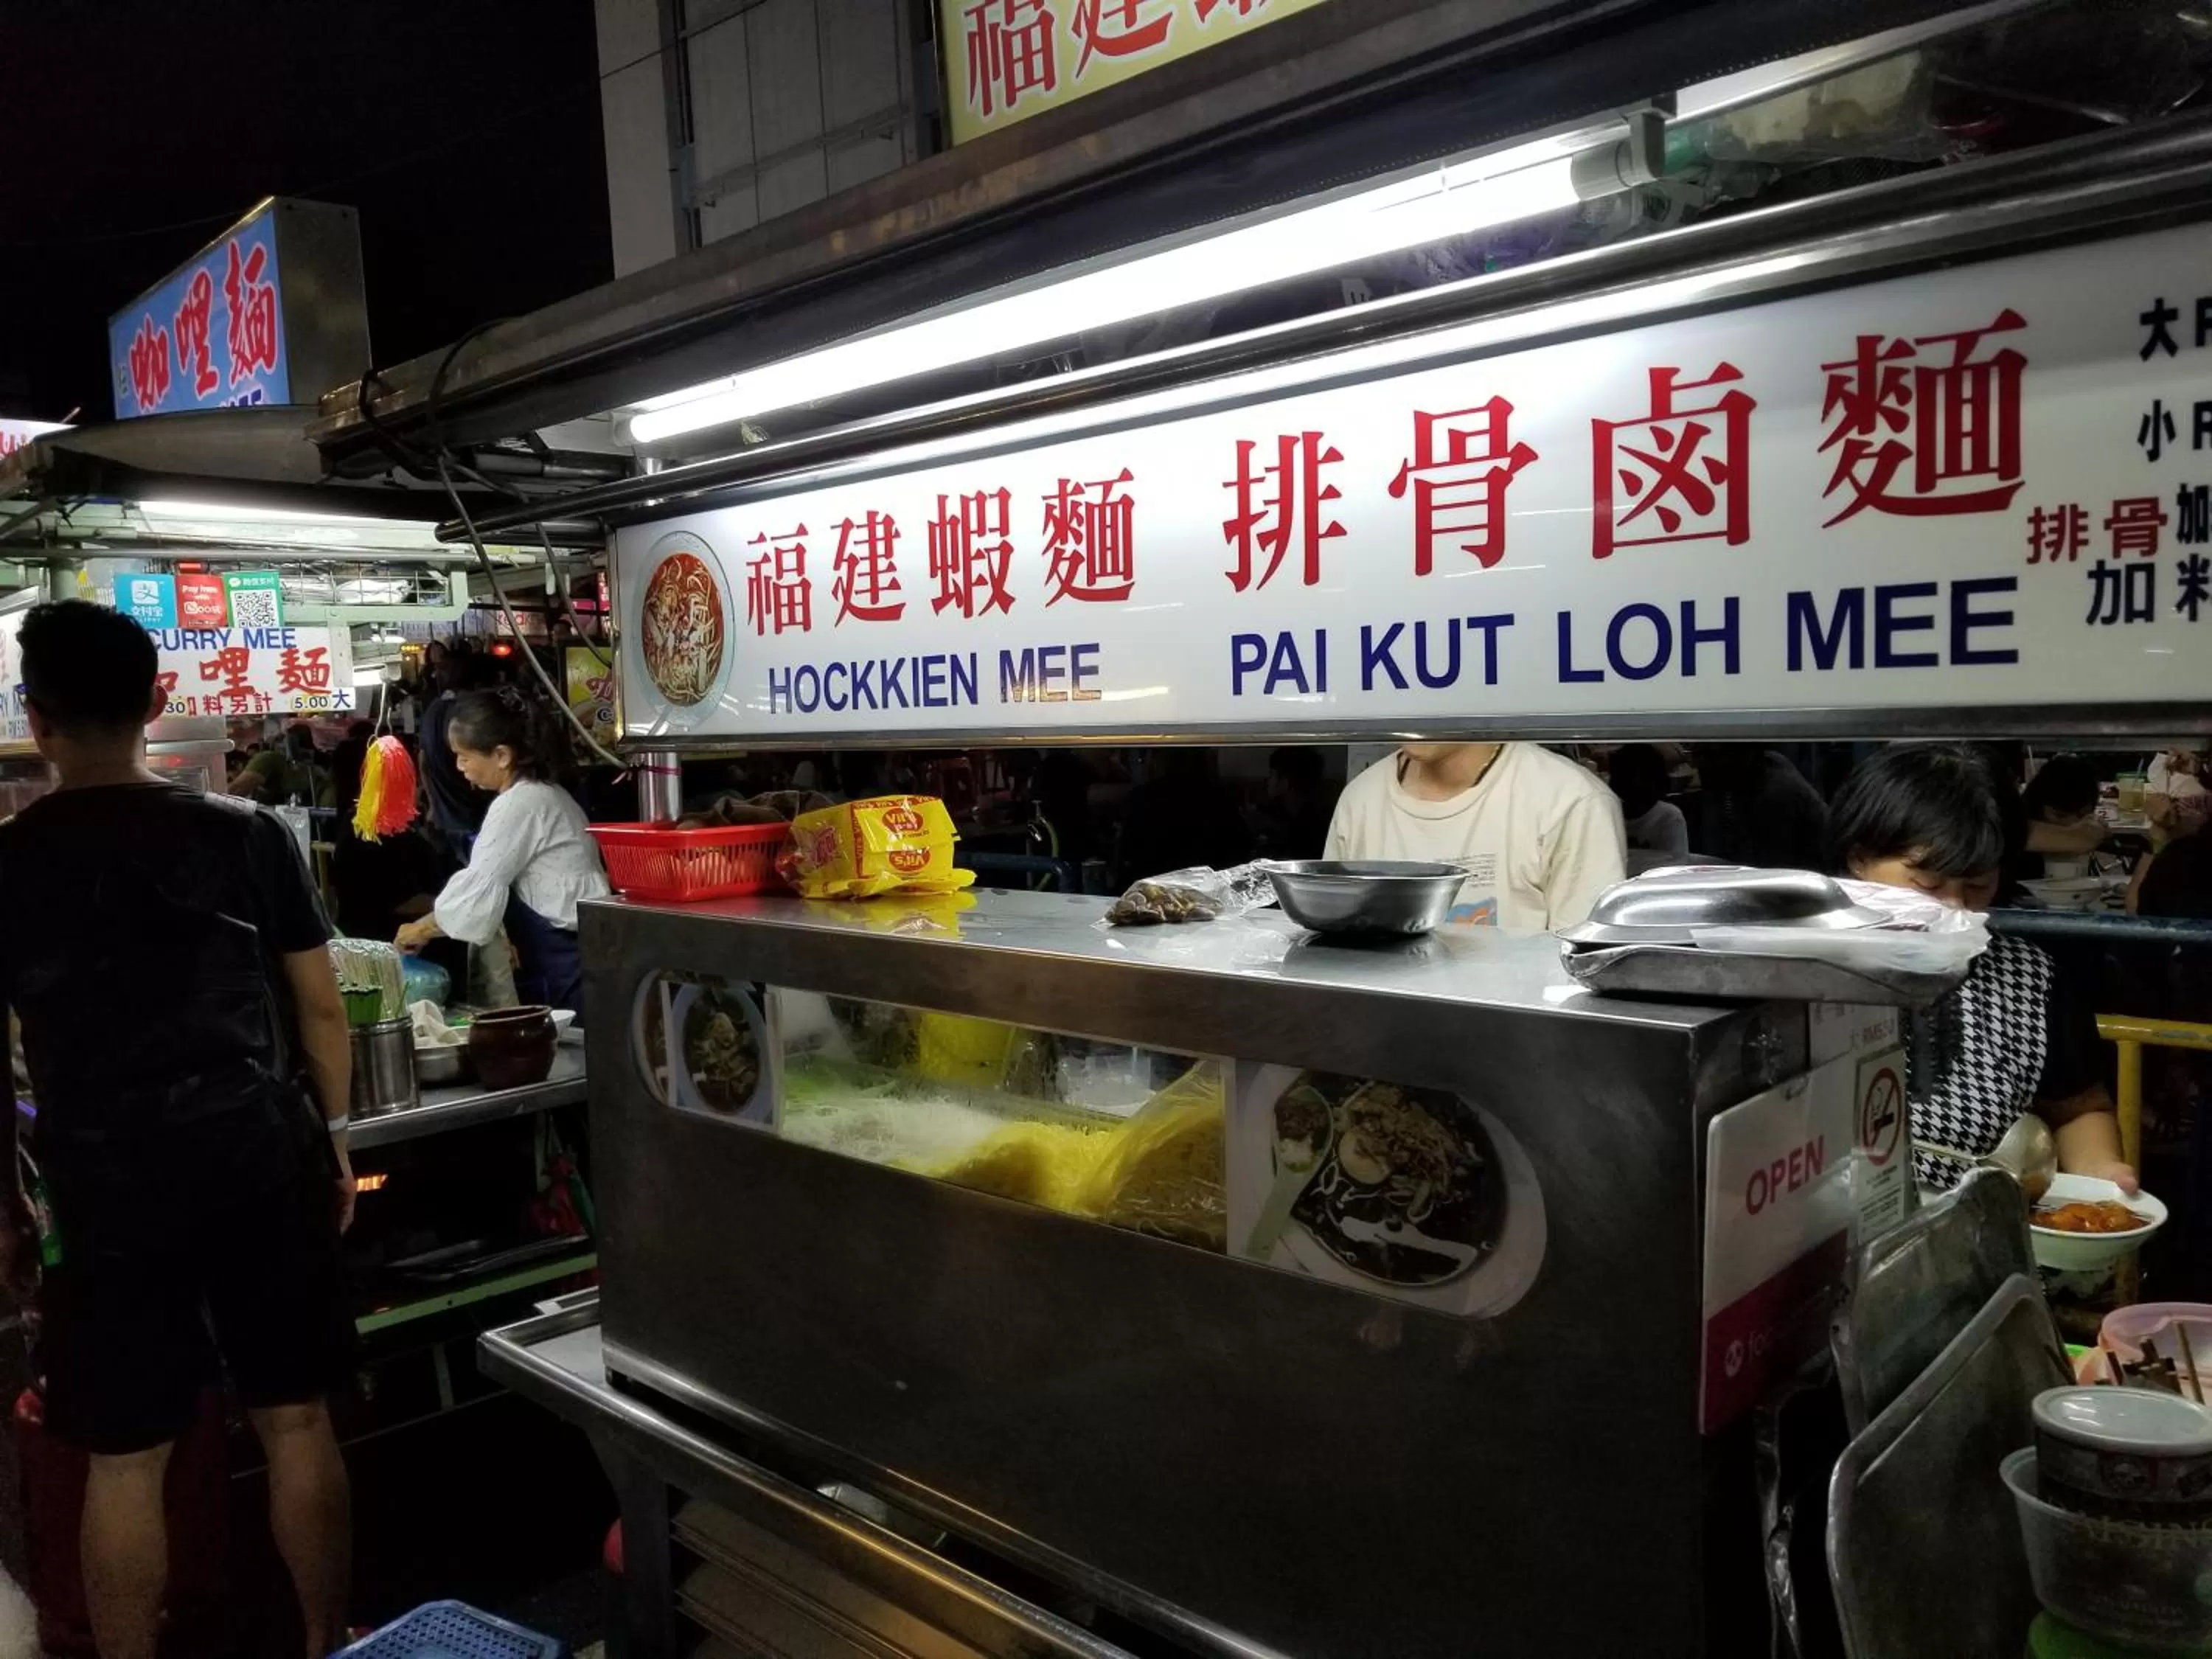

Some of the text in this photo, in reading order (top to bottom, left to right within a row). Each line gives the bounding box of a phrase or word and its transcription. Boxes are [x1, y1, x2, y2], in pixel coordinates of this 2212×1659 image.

[965, 0, 1262, 116] 福建
[2139, 297, 2178, 361] 大
[2138, 399, 2176, 462] 小
[746, 469, 1135, 636] 福建蝦麵
[2025, 496, 2168, 565] 排骨
[243, 627, 296, 650] MEE
[1231, 576, 2019, 695] PAI KUT LOH MEE
[294, 696, 328, 709] 5.00
[332, 688, 350, 709] 大
[769, 642, 1102, 714] HOCKKIEN MEE
[1746, 1134, 1825, 1216] OPEN
